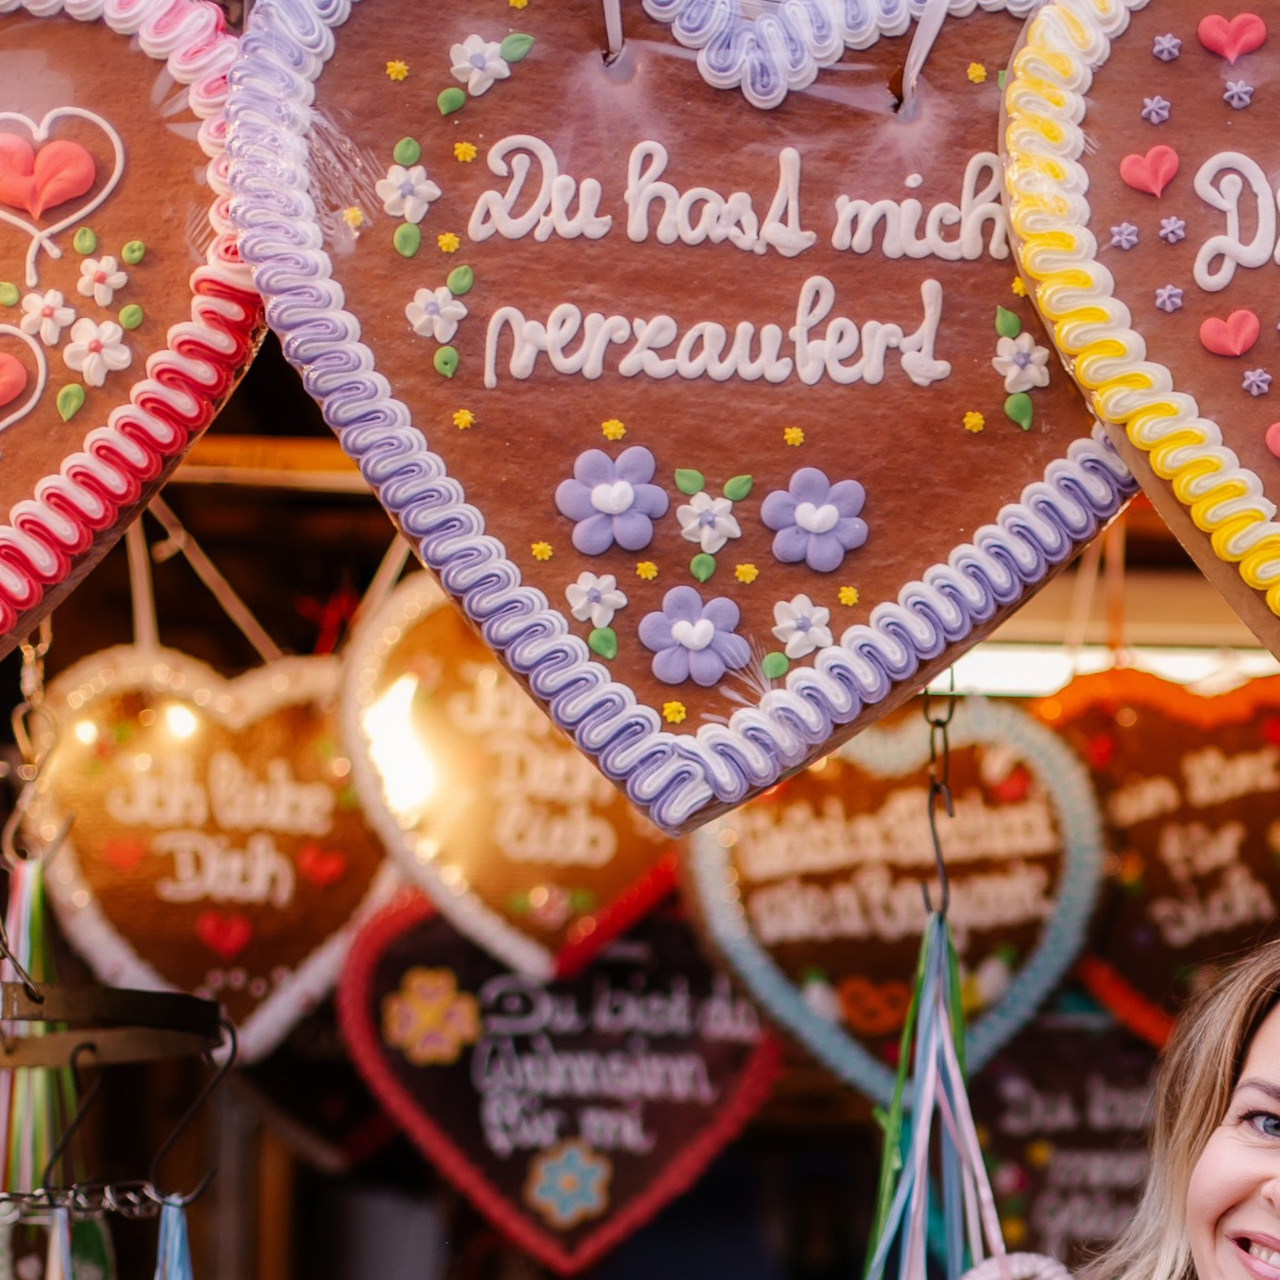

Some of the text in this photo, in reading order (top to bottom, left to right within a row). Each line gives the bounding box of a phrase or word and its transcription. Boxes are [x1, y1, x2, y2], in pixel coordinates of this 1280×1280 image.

[468, 135, 1009, 260] Du hast mich
[484, 275, 951, 388] verzaubert
[154, 829, 295, 908] Dich
